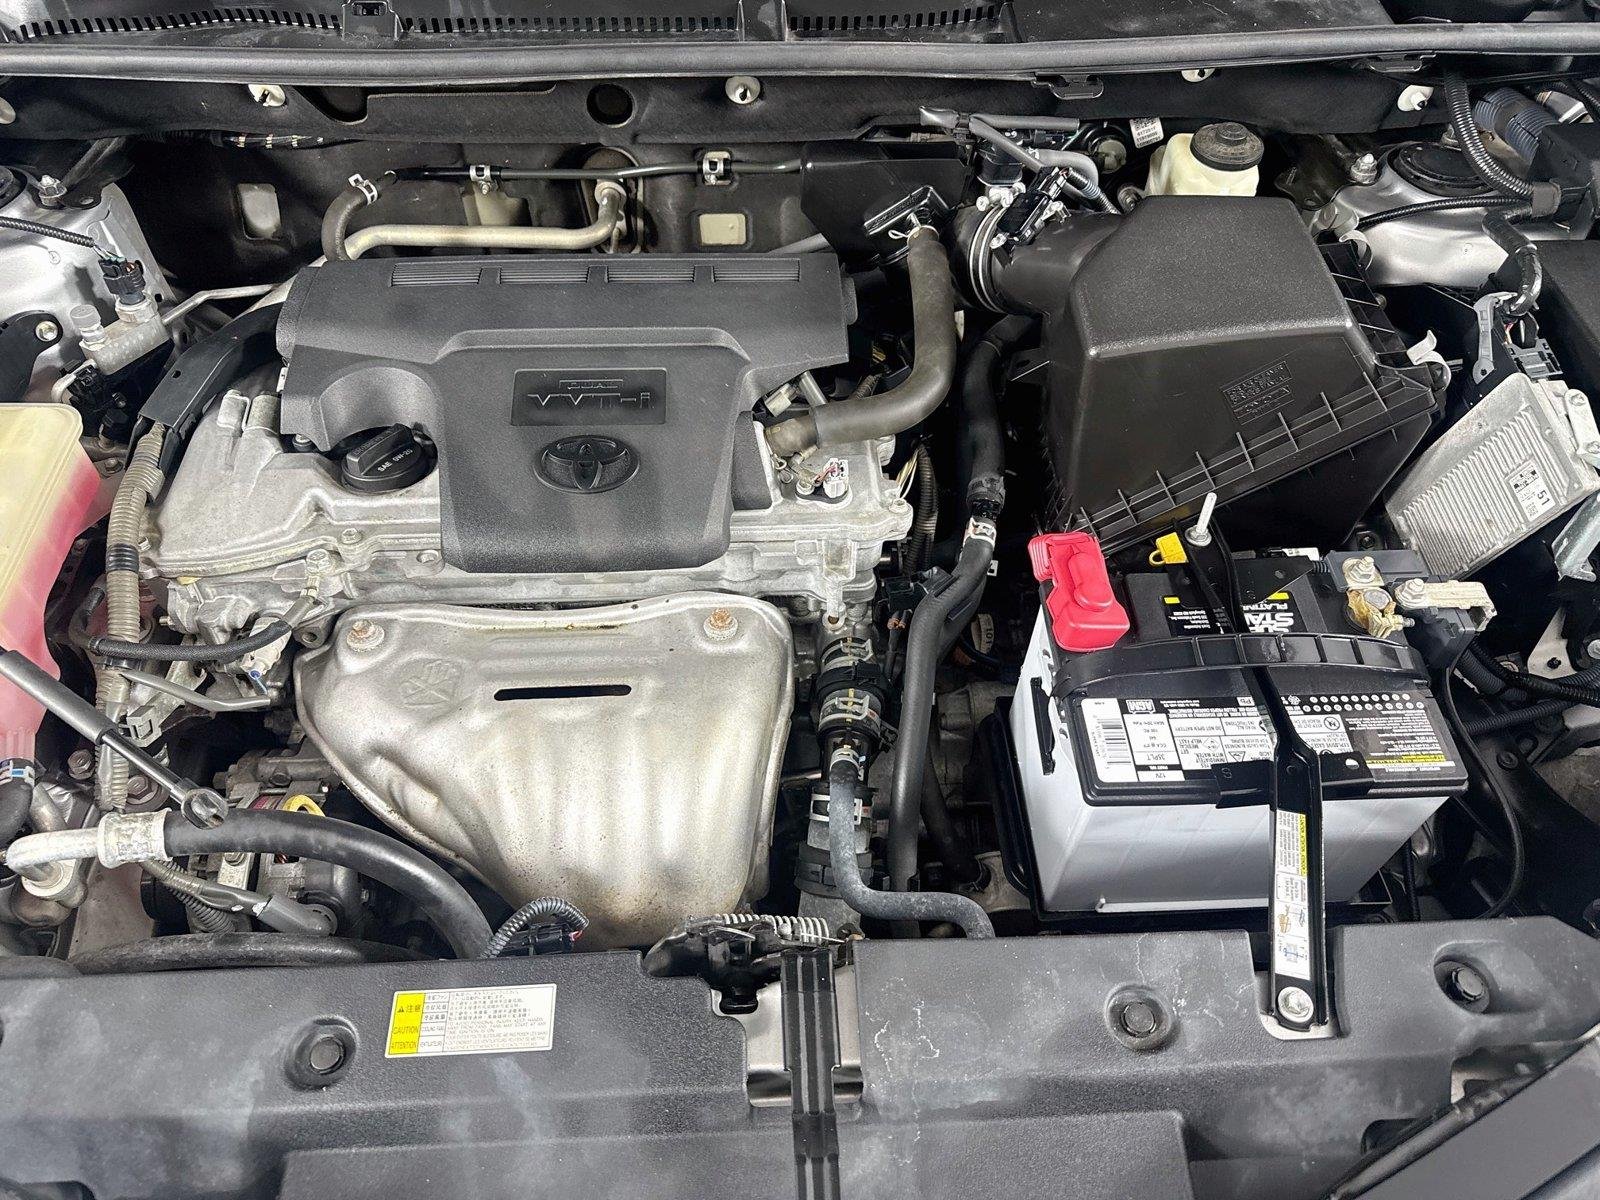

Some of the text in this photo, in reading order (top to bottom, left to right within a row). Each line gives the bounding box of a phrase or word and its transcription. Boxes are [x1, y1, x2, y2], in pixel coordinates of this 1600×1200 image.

[377, 461, 393, 472] SAE
[1147, 753, 1166, 761] 35PLT
[391, 1025, 419, 1035] CAUTION
